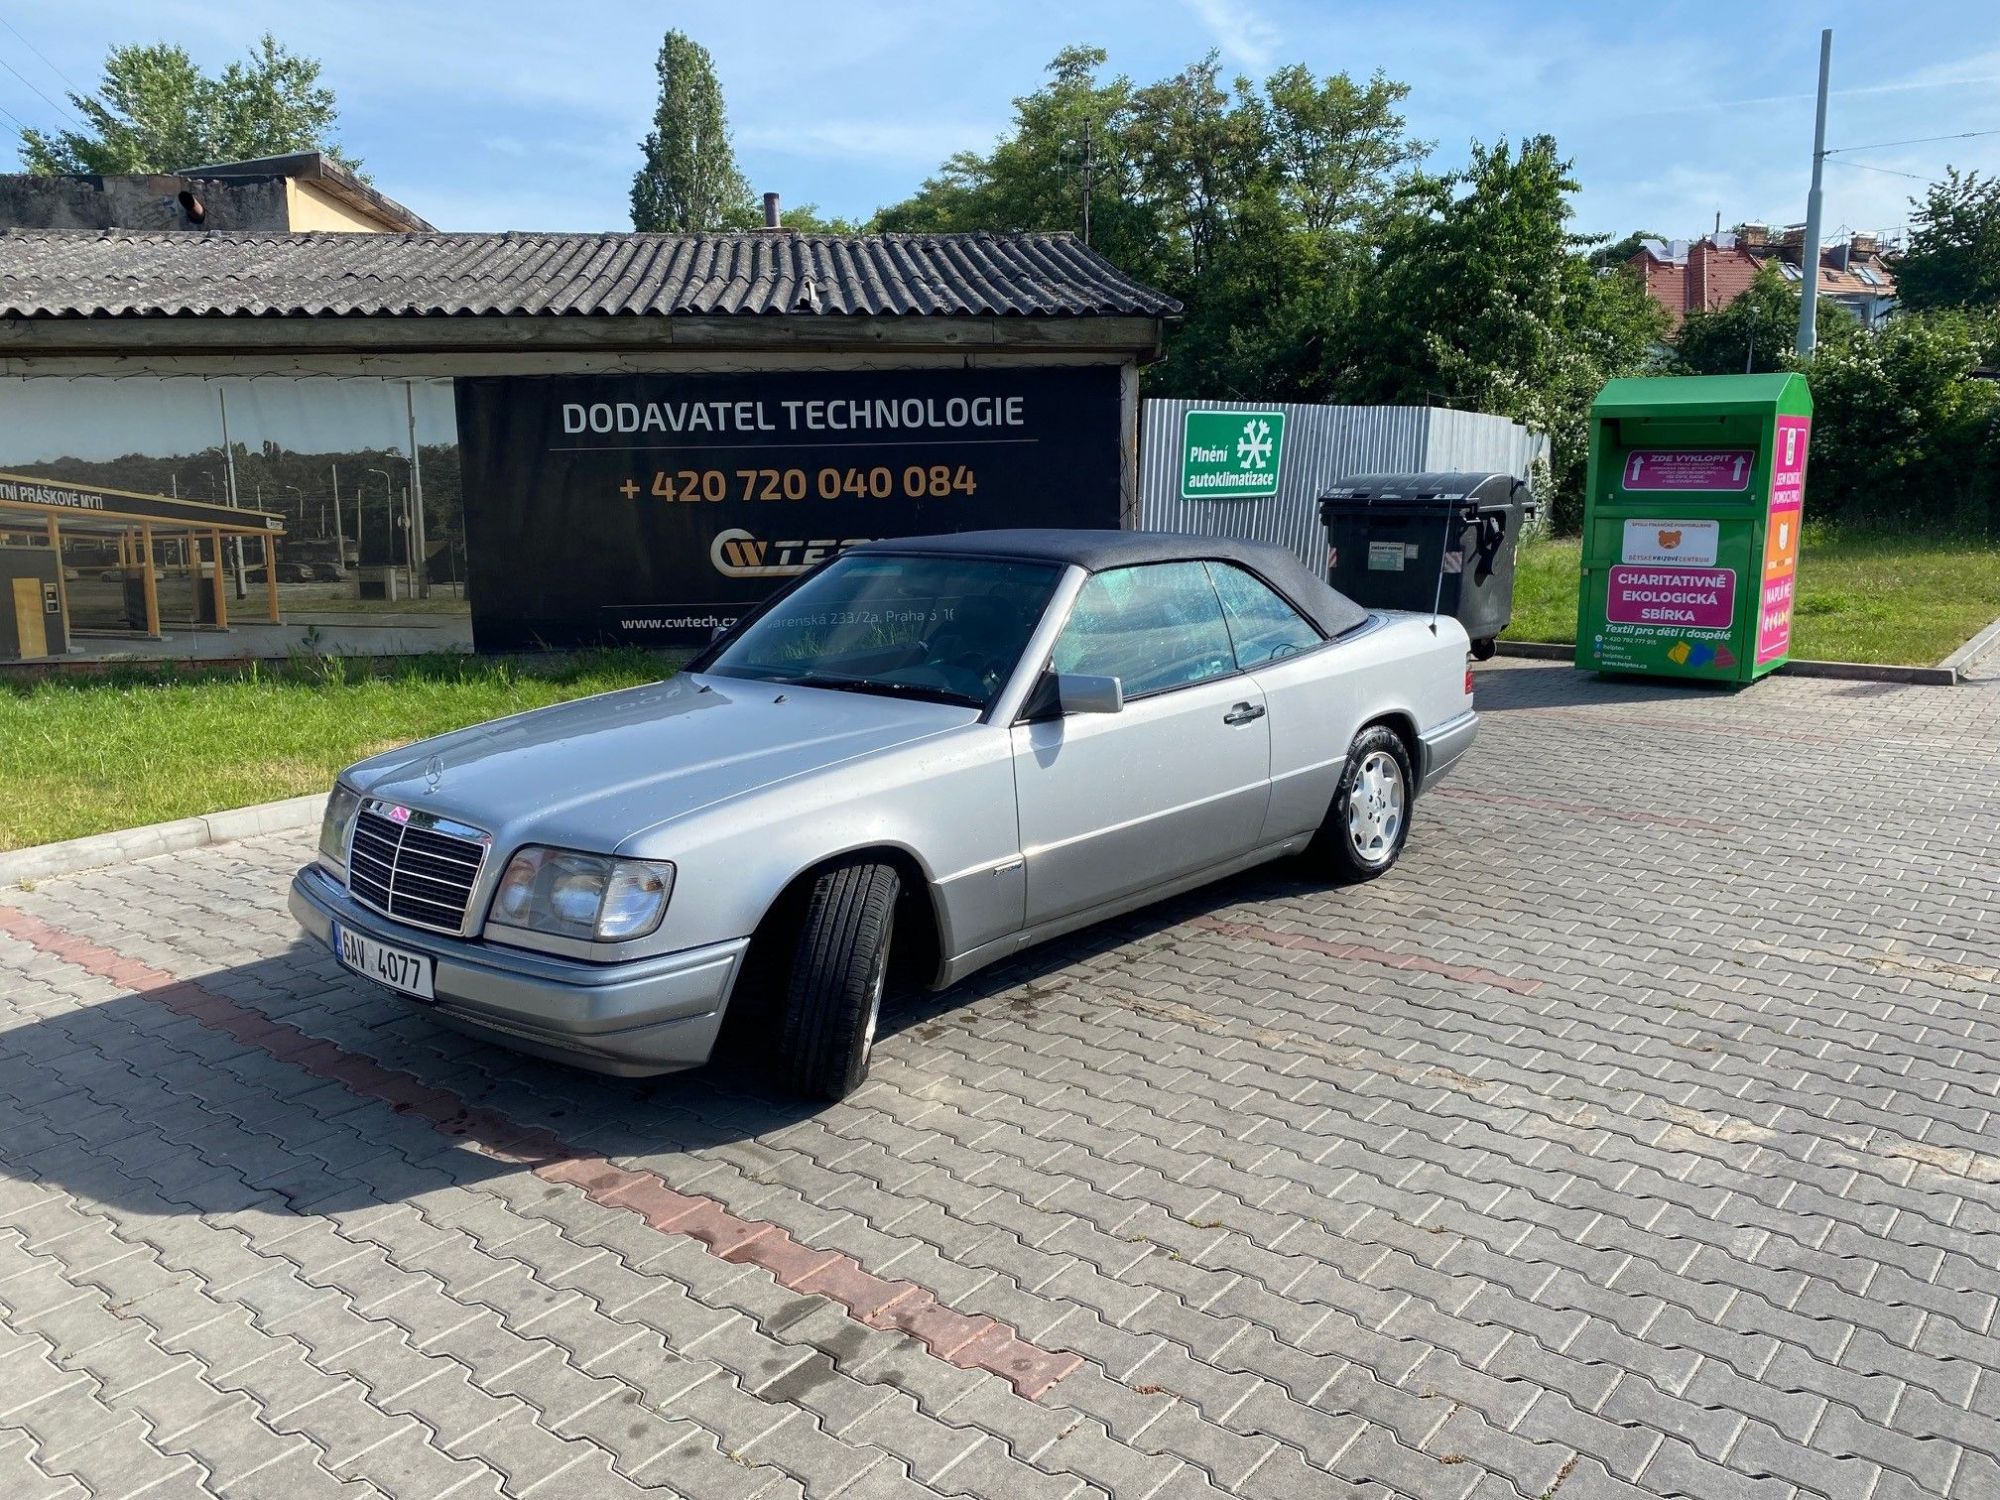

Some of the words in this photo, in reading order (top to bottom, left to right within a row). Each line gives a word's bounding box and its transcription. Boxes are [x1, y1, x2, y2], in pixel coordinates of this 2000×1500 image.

[563, 402, 775, 433] DODAVATEL
[781, 397, 1024, 430] TECHNOLOGIE
[1190, 444, 1228, 463] Plnění
[620, 479, 640, 500] +
[651, 470, 726, 502] 420
[736, 469, 807, 501] 720
[818, 467, 893, 499] 040
[903, 465, 977, 496] 084
[1188, 471, 1274, 488] autoklimatizace
[19, 485, 79, 507] PRÁŠKOVÉ
[1618, 572, 1726, 588] CHARITATIVNĚ
[1622, 590, 1718, 605] EKOLOGICKÁ
[621, 615, 738, 629] www.cwtech.cz
[886, 609, 924, 622] Praha
[1641, 606, 1695, 621] SBÍRKA
[1605, 624, 1633, 634] Textil
[1635, 627, 1655, 637] pro
[1687, 629, 1731, 641] dospělé
[343, 931, 364, 969] 6AV
[378, 948, 420, 989] 4077
